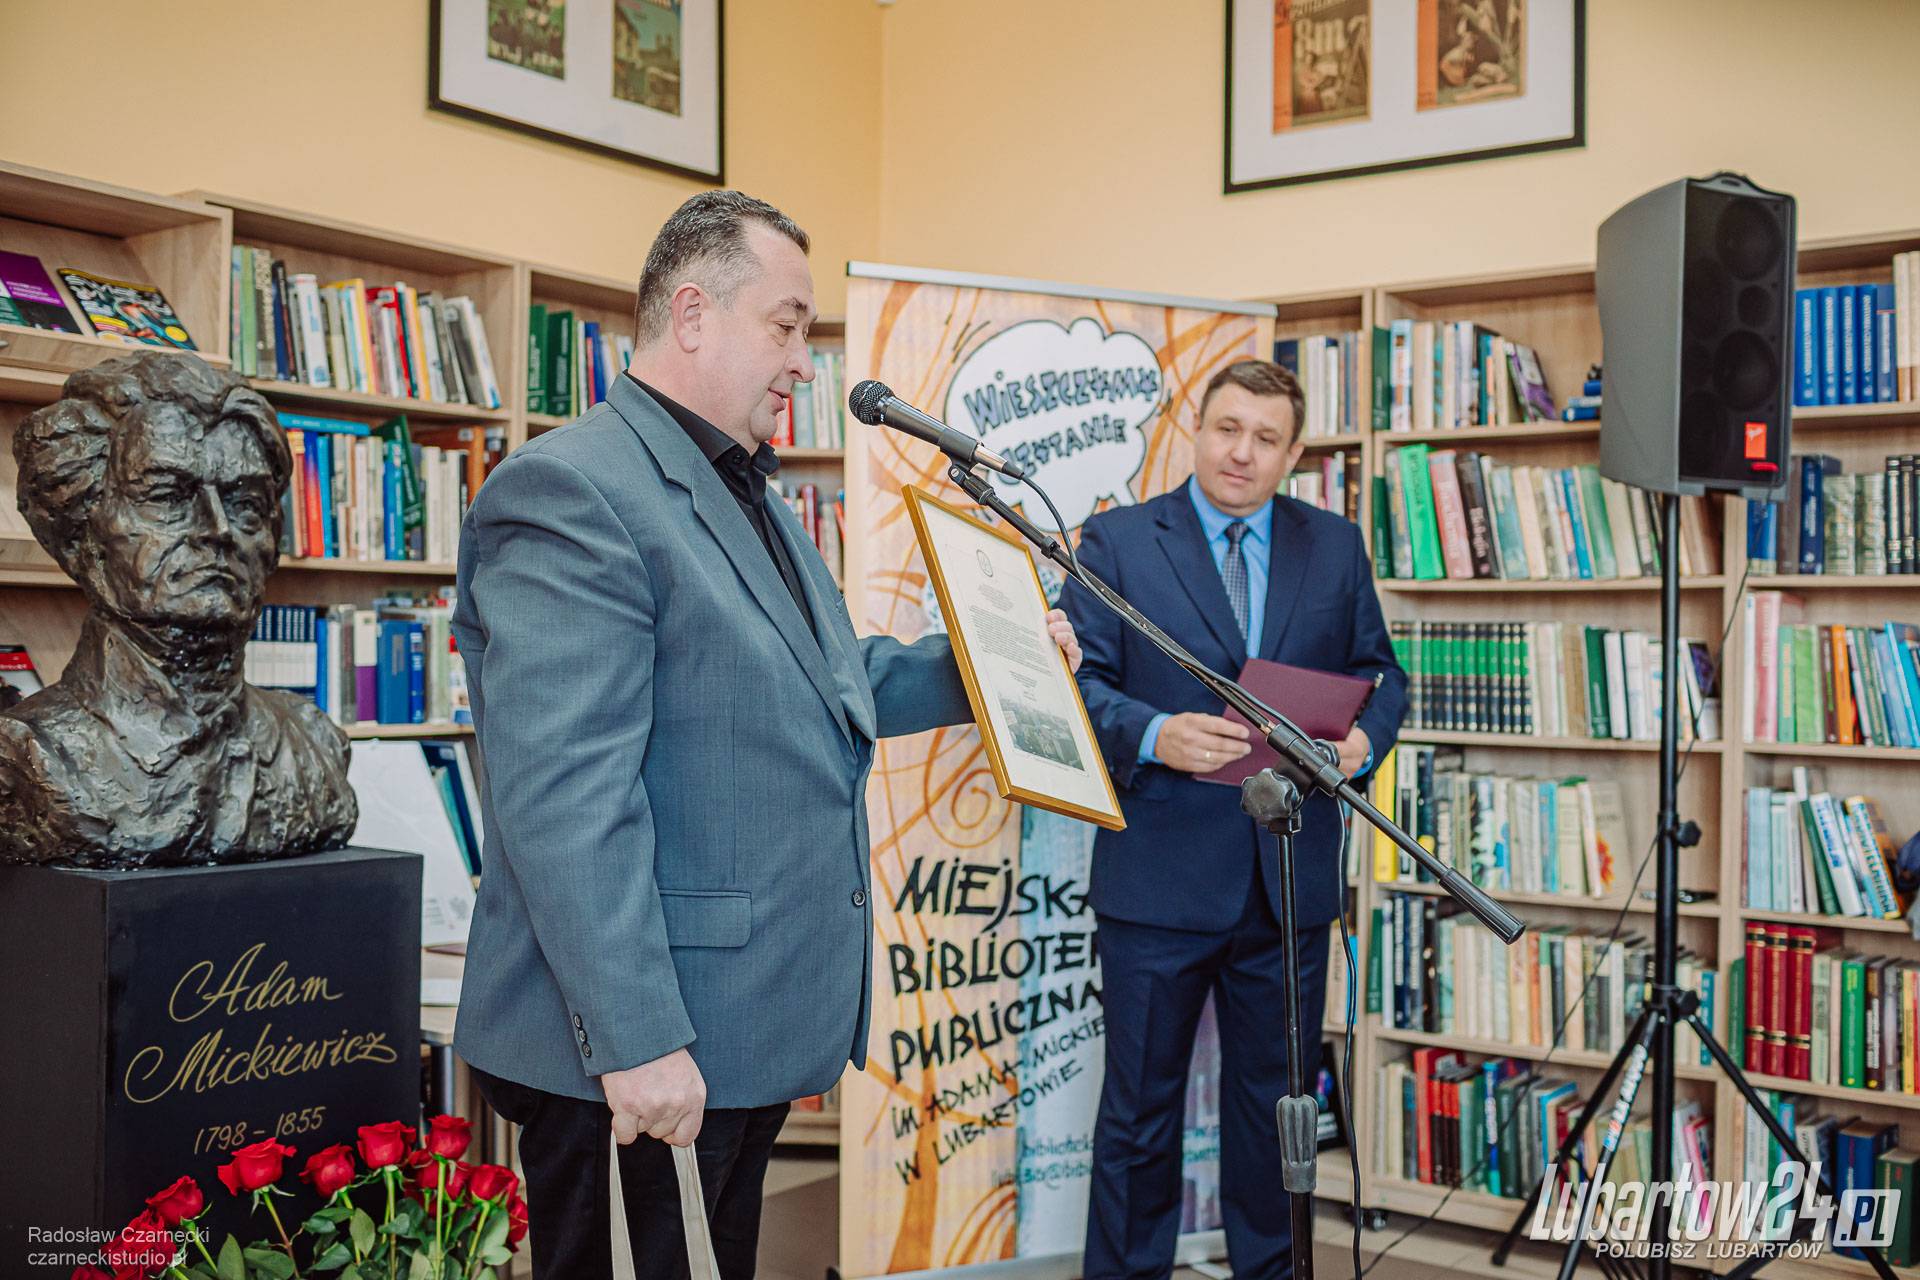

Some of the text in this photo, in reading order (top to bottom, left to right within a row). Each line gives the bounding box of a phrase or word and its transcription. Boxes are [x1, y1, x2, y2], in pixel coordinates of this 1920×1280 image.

[168, 942, 344, 1023] Adam
[889, 931, 1100, 998] BIBLIOTE
[124, 1023, 398, 1104] Mickiewicz
[890, 980, 1104, 1085] PUBLICZNA
[926, 1059, 1024, 1122] ADAMA
[1032, 1014, 1106, 1068] MICKIE
[193, 1121, 248, 1155] 1798
[274, 1105, 327, 1138] 1855
[895, 1151, 922, 1186] W
[931, 1058, 1084, 1166] LUBARTOWIE
